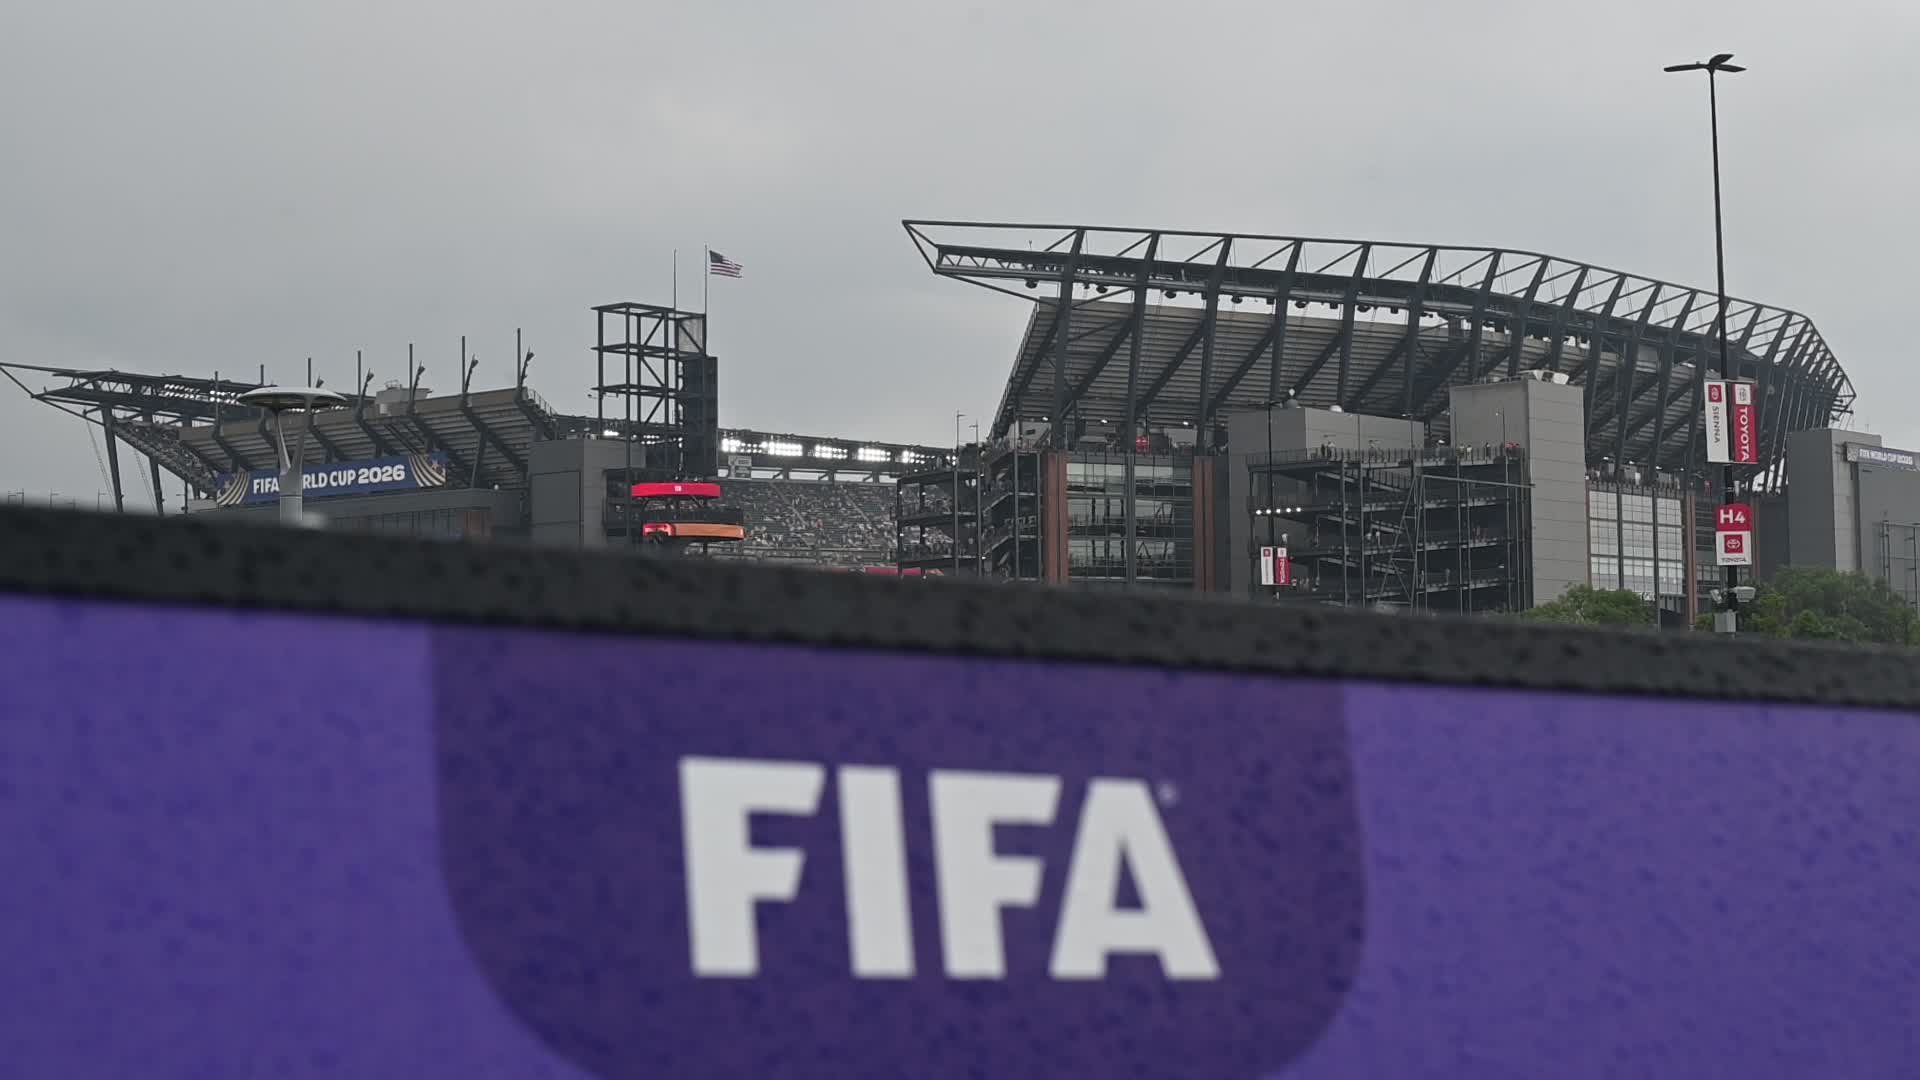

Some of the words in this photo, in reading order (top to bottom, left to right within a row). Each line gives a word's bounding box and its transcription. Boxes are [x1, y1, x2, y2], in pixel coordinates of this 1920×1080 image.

[1712, 406, 1721, 444] SIENNA
[1740, 407, 1749, 462] TOYOTA
[253, 478, 279, 494] FIFA
[302, 472, 327, 489] RLD
[330, 470, 356, 487] CUP
[358, 464, 405, 484] 2026
[1720, 509, 1745, 523] H4
[679, 756, 1221, 980] FIFA
